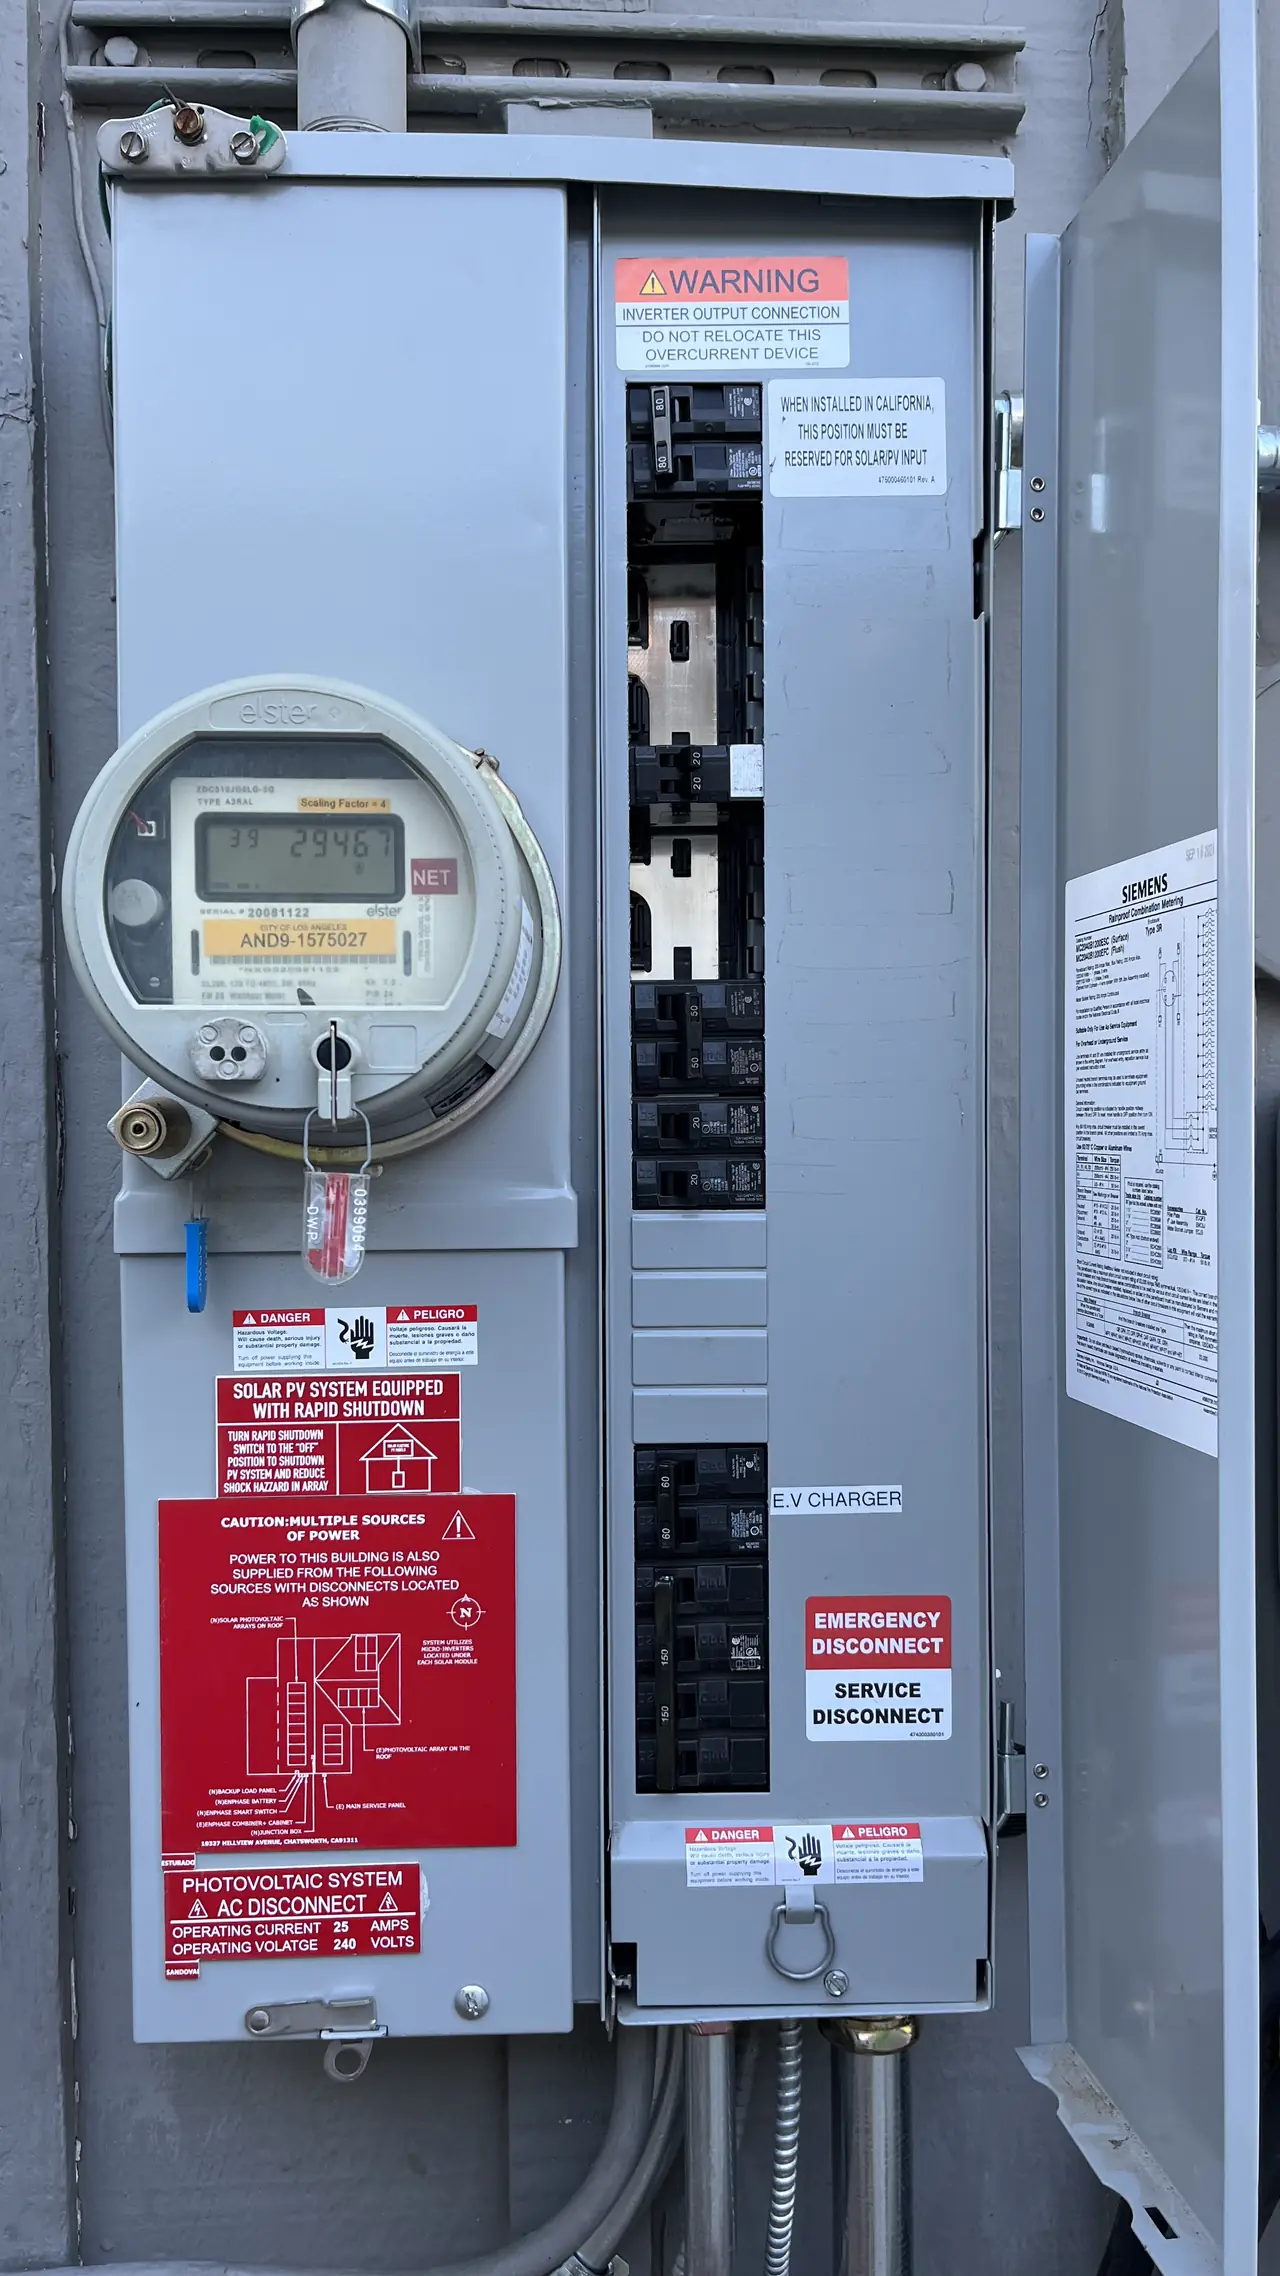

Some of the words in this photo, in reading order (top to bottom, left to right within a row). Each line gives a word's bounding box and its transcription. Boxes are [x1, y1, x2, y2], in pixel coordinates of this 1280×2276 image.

[669, 269, 819, 294] WARNING
[623, 308, 689, 320] INVERTER
[693, 307, 748, 320] OUTPUT
[751, 306, 839, 319] CONNECTION
[643, 331, 664, 342] DO
[669, 331, 699, 342] NOT
[704, 329, 783, 342] RELOCATE
[788, 329, 821, 341] THIS
[646, 348, 759, 360] OVERCURRENT
[764, 347, 818, 359] DEVICE
[656, 398, 664, 410] 80
[781, 397, 808, 412] WHEN
[811, 396, 862, 412] INSTALLED
[865, 396, 873, 411] IN
[876, 395, 934, 413] CALIFORNIA,
[798, 424, 818, 439] THIS
[821, 423, 864, 439] POSITION
[867, 423, 892, 439] MUST
[895, 423, 907, 438] BE
[658, 456, 666, 468] 80
[785, 451, 832, 466] RESERVED
[835, 450, 852, 466] FOR
[855, 450, 899, 465] SOLAR/PV
[901, 449, 927, 465] INPUT
[239, 695, 318, 725] elster
[693, 752, 700, 765] 20
[693, 777, 701, 790] 20
[300, 798, 336, 809] Scaling
[338, 799, 369, 808] Factor
[380, 800, 386, 808] 4
[230, 829, 259, 848] 39
[290, 828, 391, 858] 29467
[412, 868, 451, 886] NET
[1122, 873, 1168, 903] SIEMENS
[247, 908, 310, 918] 20081122
[366, 904, 401, 917] elster
[1108, 911, 1130, 924] Rainproof
[1130, 902, 1160, 917] Combination
[1161, 896, 1184, 907] Metering
[240, 931, 368, 949] AND9-1575027
[690, 1005, 698, 1017] 50
[691, 1057, 699, 1069] 50
[693, 1117, 700, 1129] 20
[691, 1174, 698, 1185] 20
[353, 1189, 367, 1252] 0399084
[261, 1313, 310, 1323] DANGER
[414, 1309, 464, 1319] PELIGRO
[233, 1382, 282, 1399] SOLAR
[286, 1382, 305, 1398] PV
[310, 1381, 367, 1397] SYSTEM
[373, 1380, 443, 1396] EQUIPPED
[253, 1403, 289, 1419] WITH
[295, 1402, 338, 1418] RAPID
[343, 1400, 424, 1417] SHUTDOWN
[228, 1431, 249, 1441] TURN
[252, 1431, 276, 1441] RAPID
[278, 1430, 323, 1440] SHUTDOWN
[233, 1444, 264, 1454] SWITCH
[266, 1443, 276, 1453] TO
[278, 1443, 294, 1453] THE
[228, 1456, 265, 1467] POSITION
[266, 1456, 277, 1466] TO
[279, 1455, 324, 1466] SHUTDOWN
[227, 1470, 238, 1480] PV
[240, 1469, 272, 1480] SYSTEM
[274, 1469, 291, 1479] AND
[293, 1468, 325, 1478] REDUCE
[223, 1482, 251, 1493] SHOCK
[253, 1481, 289, 1492] HAZZARD
[291, 1481, 300, 1491] IN
[302, 1481, 328, 1491] ARRAY
[661, 1476, 670, 1488] 60
[773, 1493, 802, 1508] E.V
[808, 1491, 902, 1507] CHARGER
[221, 1515, 358, 1527] CAUTION:MULTIPLE
[362, 1514, 425, 1525] SOURCES
[287, 1531, 305, 1541] OF
[309, 1530, 360, 1540] POWER
[662, 1528, 670, 1540] 60
[230, 1554, 276, 1564] POWER
[279, 1553, 296, 1563] TO
[300, 1553, 328, 1563] THIS
[331, 1552, 389, 1563] BUILDING
[392, 1551, 404, 1561] IS
[407, 1551, 439, 1561] ALSO
[233, 1568, 293, 1579] SUPPLIED
[297, 1567, 333, 1578] FROM
[336, 1567, 361, 1577] THE
[364, 1566, 437, 1576] FOLLOWING
[211, 1583, 271, 1594] SOURCES
[274, 1583, 306, 1593] WITH
[309, 1581, 398, 1592] DISCONNECTS
[402, 1580, 459, 1591] LOCATED
[302, 1597, 319, 1607] AS
[322, 1596, 369, 1607] SHOWN
[460, 1607, 472, 1618] N
[815, 1612, 940, 1628] EMERGENCY
[813, 1637, 943, 1654] DISCONNECT
[661, 1649, 669, 1666] 150
[835, 1683, 921, 1698] SERVICE
[661, 1706, 669, 1723] 150
[813, 1708, 944, 1724] DISCONNECT
[712, 1830, 759, 1840] DANGER
[858, 1827, 907, 1837] PELIGRO
[183, 1874, 322, 1893] PHOTOVOLTAIC
[328, 1871, 402, 1888] SYSTEM
[217, 1899, 242, 1917] AC
[248, 1894, 367, 1916] DISCONNECT
[172, 1925, 251, 1938] OPERATING
[255, 1922, 321, 1935] CURRENT
[334, 1922, 349, 1933] 25
[371, 1919, 409, 1931] AMPS
[173, 1941, 251, 1955] OPERATING
[255, 1939, 318, 1952] VOLATGE
[334, 1939, 356, 1950] 240
[371, 1936, 414, 1948] VOLTS
